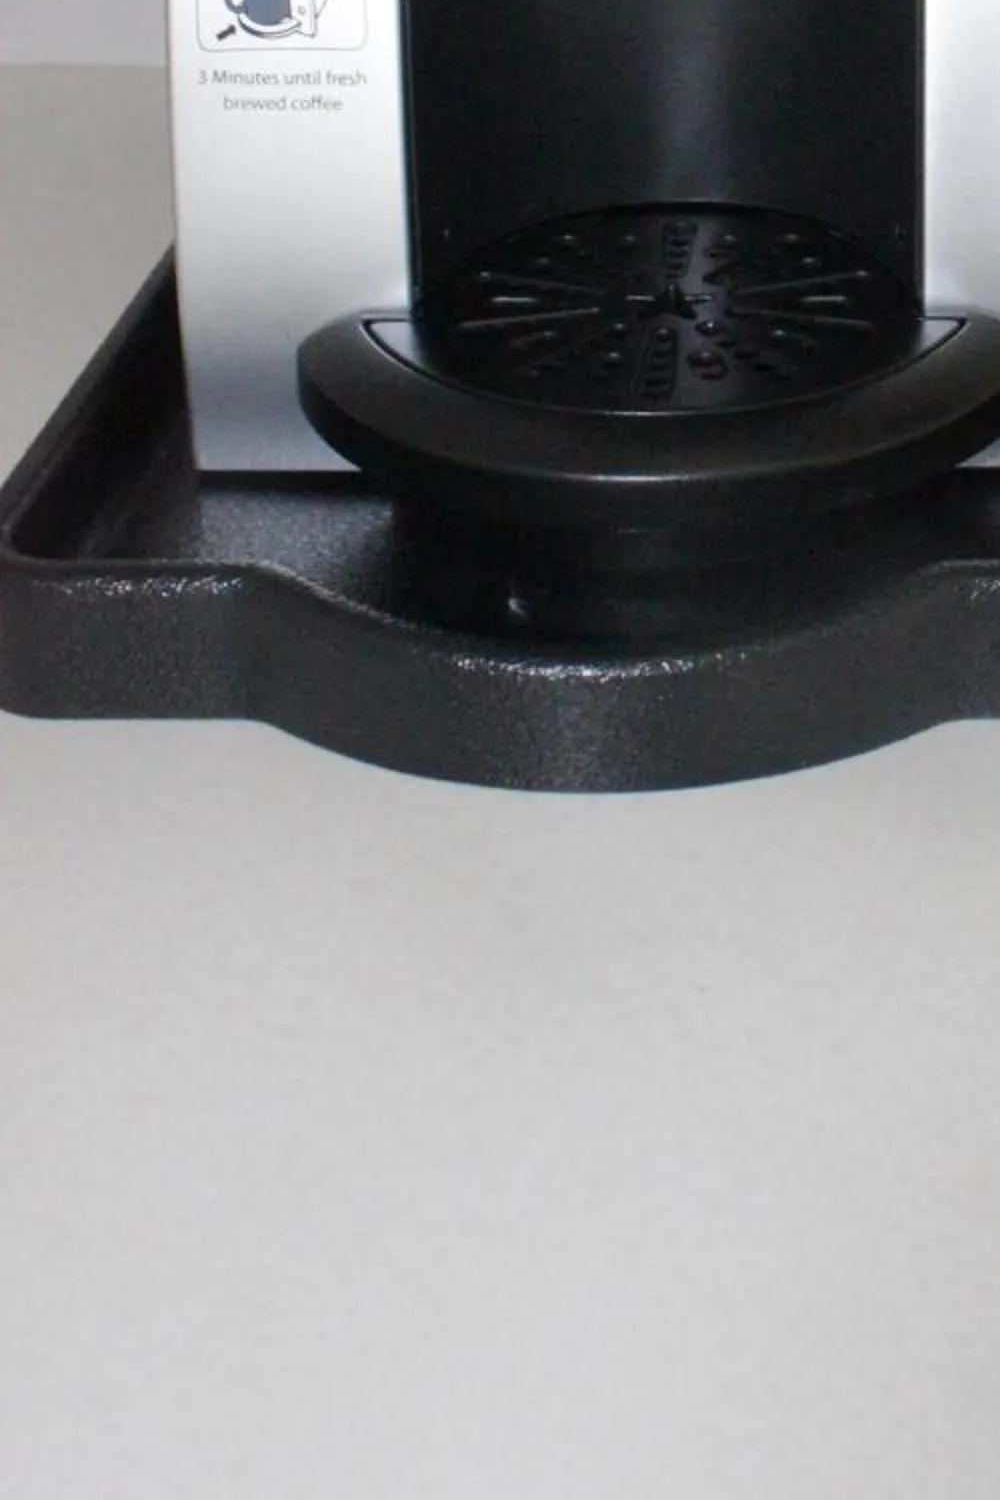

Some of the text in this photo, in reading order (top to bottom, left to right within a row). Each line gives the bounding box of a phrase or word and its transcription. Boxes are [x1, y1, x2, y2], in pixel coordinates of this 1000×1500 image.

[198, 69, 368, 86] 3 Minutes until fresh
[223, 93, 344, 111] brewed coffee
